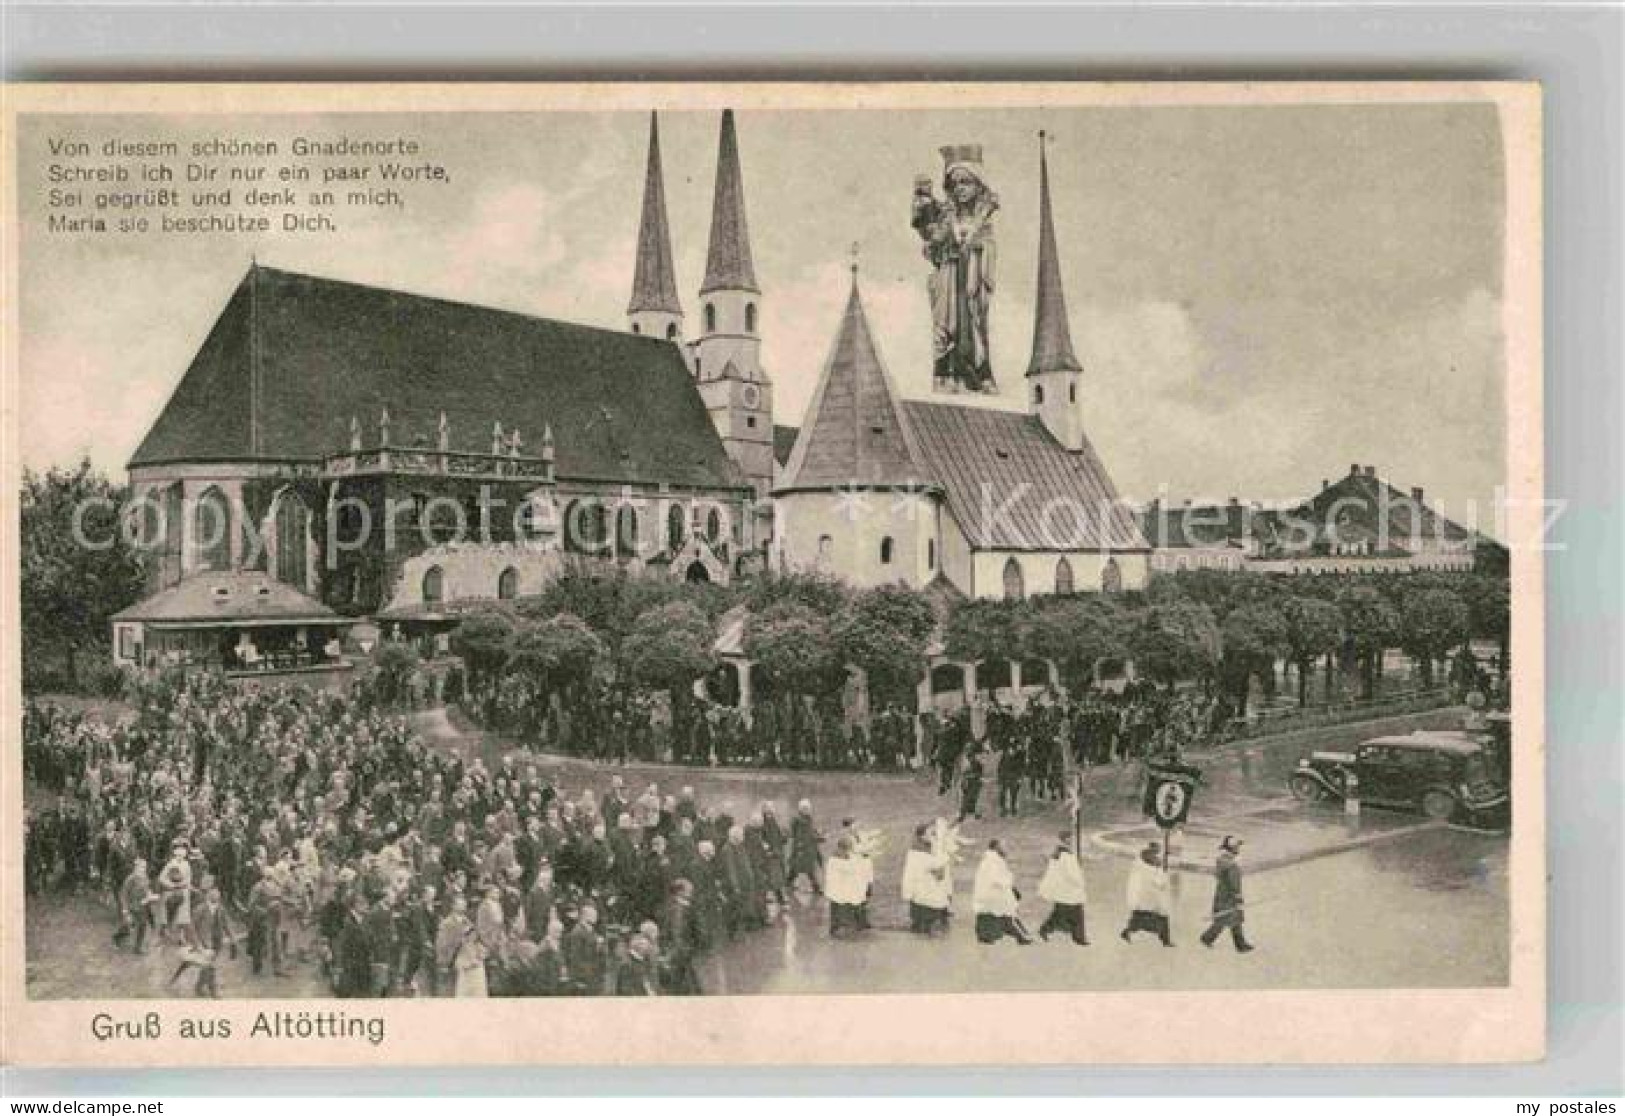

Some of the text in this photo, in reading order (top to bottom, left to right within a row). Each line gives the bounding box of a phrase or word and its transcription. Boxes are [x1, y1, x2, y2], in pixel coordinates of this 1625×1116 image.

[48, 137, 419, 156] Von diesem schönen Gnadenorte
[48, 163, 451, 187] Schreib ich Dir nur ein paar Worte,
[48, 188, 404, 210] Sei gegrüßt und denk an mich,
[48, 214, 337, 234] Maria sie beschütze Dich.
[92, 1011, 384, 1045] Gruß aus Altötting
